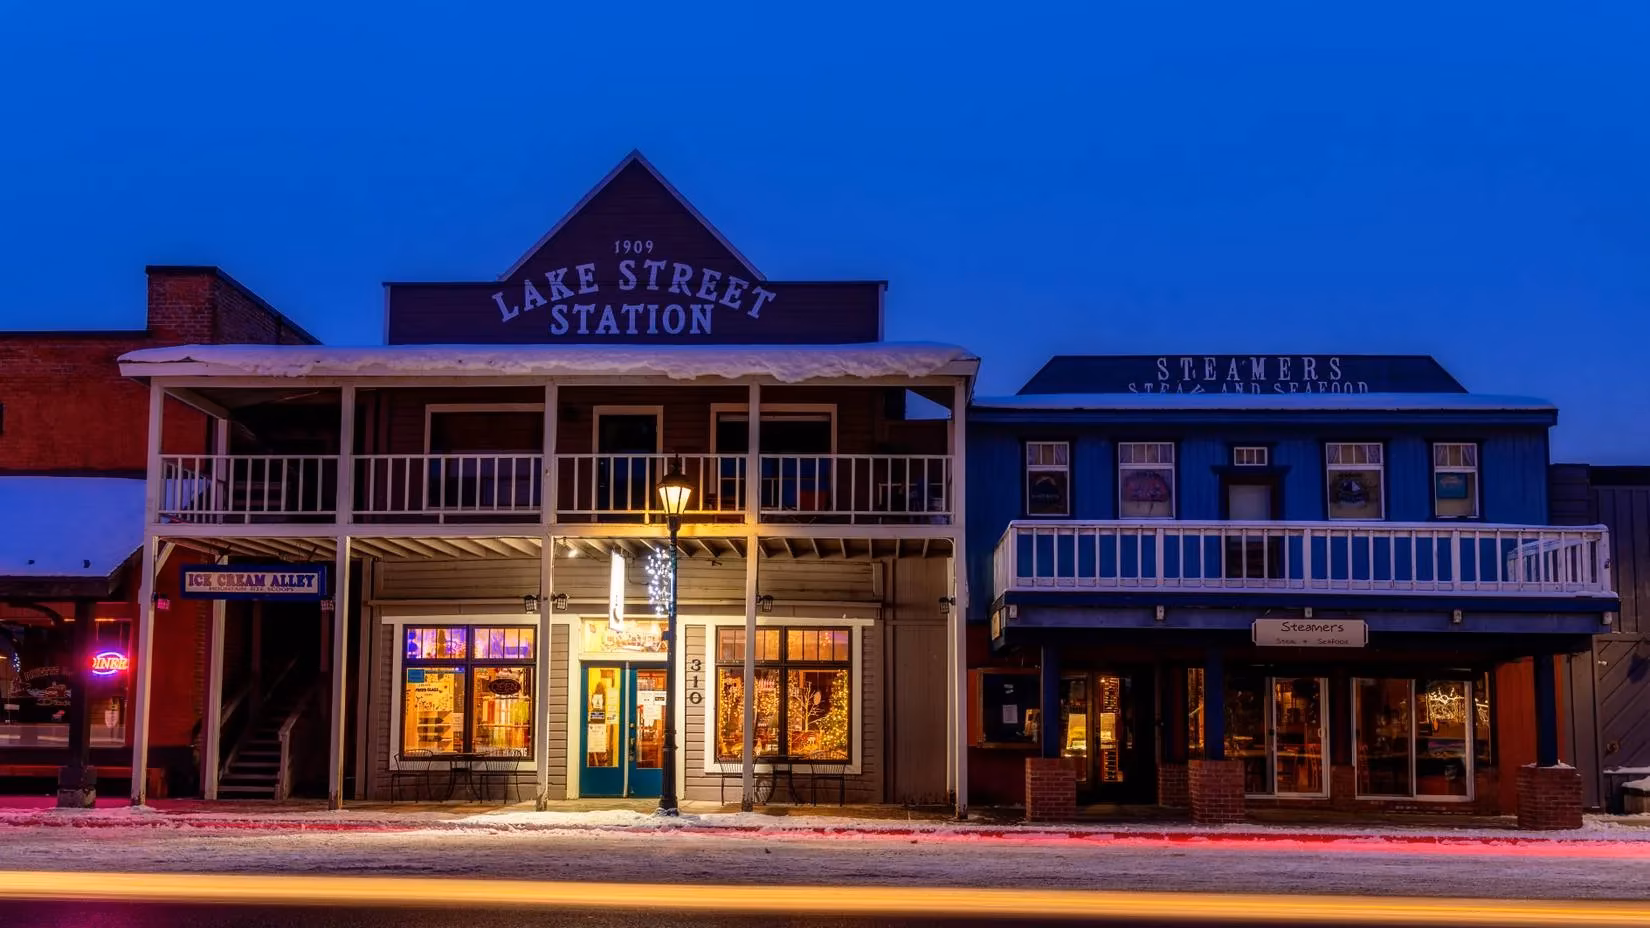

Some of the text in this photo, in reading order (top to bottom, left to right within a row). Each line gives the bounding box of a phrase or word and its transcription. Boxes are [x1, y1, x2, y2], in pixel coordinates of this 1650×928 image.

[614, 240, 654, 254] 1909
[491, 259, 777, 323] LAKE STREET
[550, 303, 714, 335] STATION
[1157, 357, 1342, 381] STEAMERS
[188, 573, 315, 588] ICE CREAM ALLEY
[1280, 621, 1345, 632] Steamers
